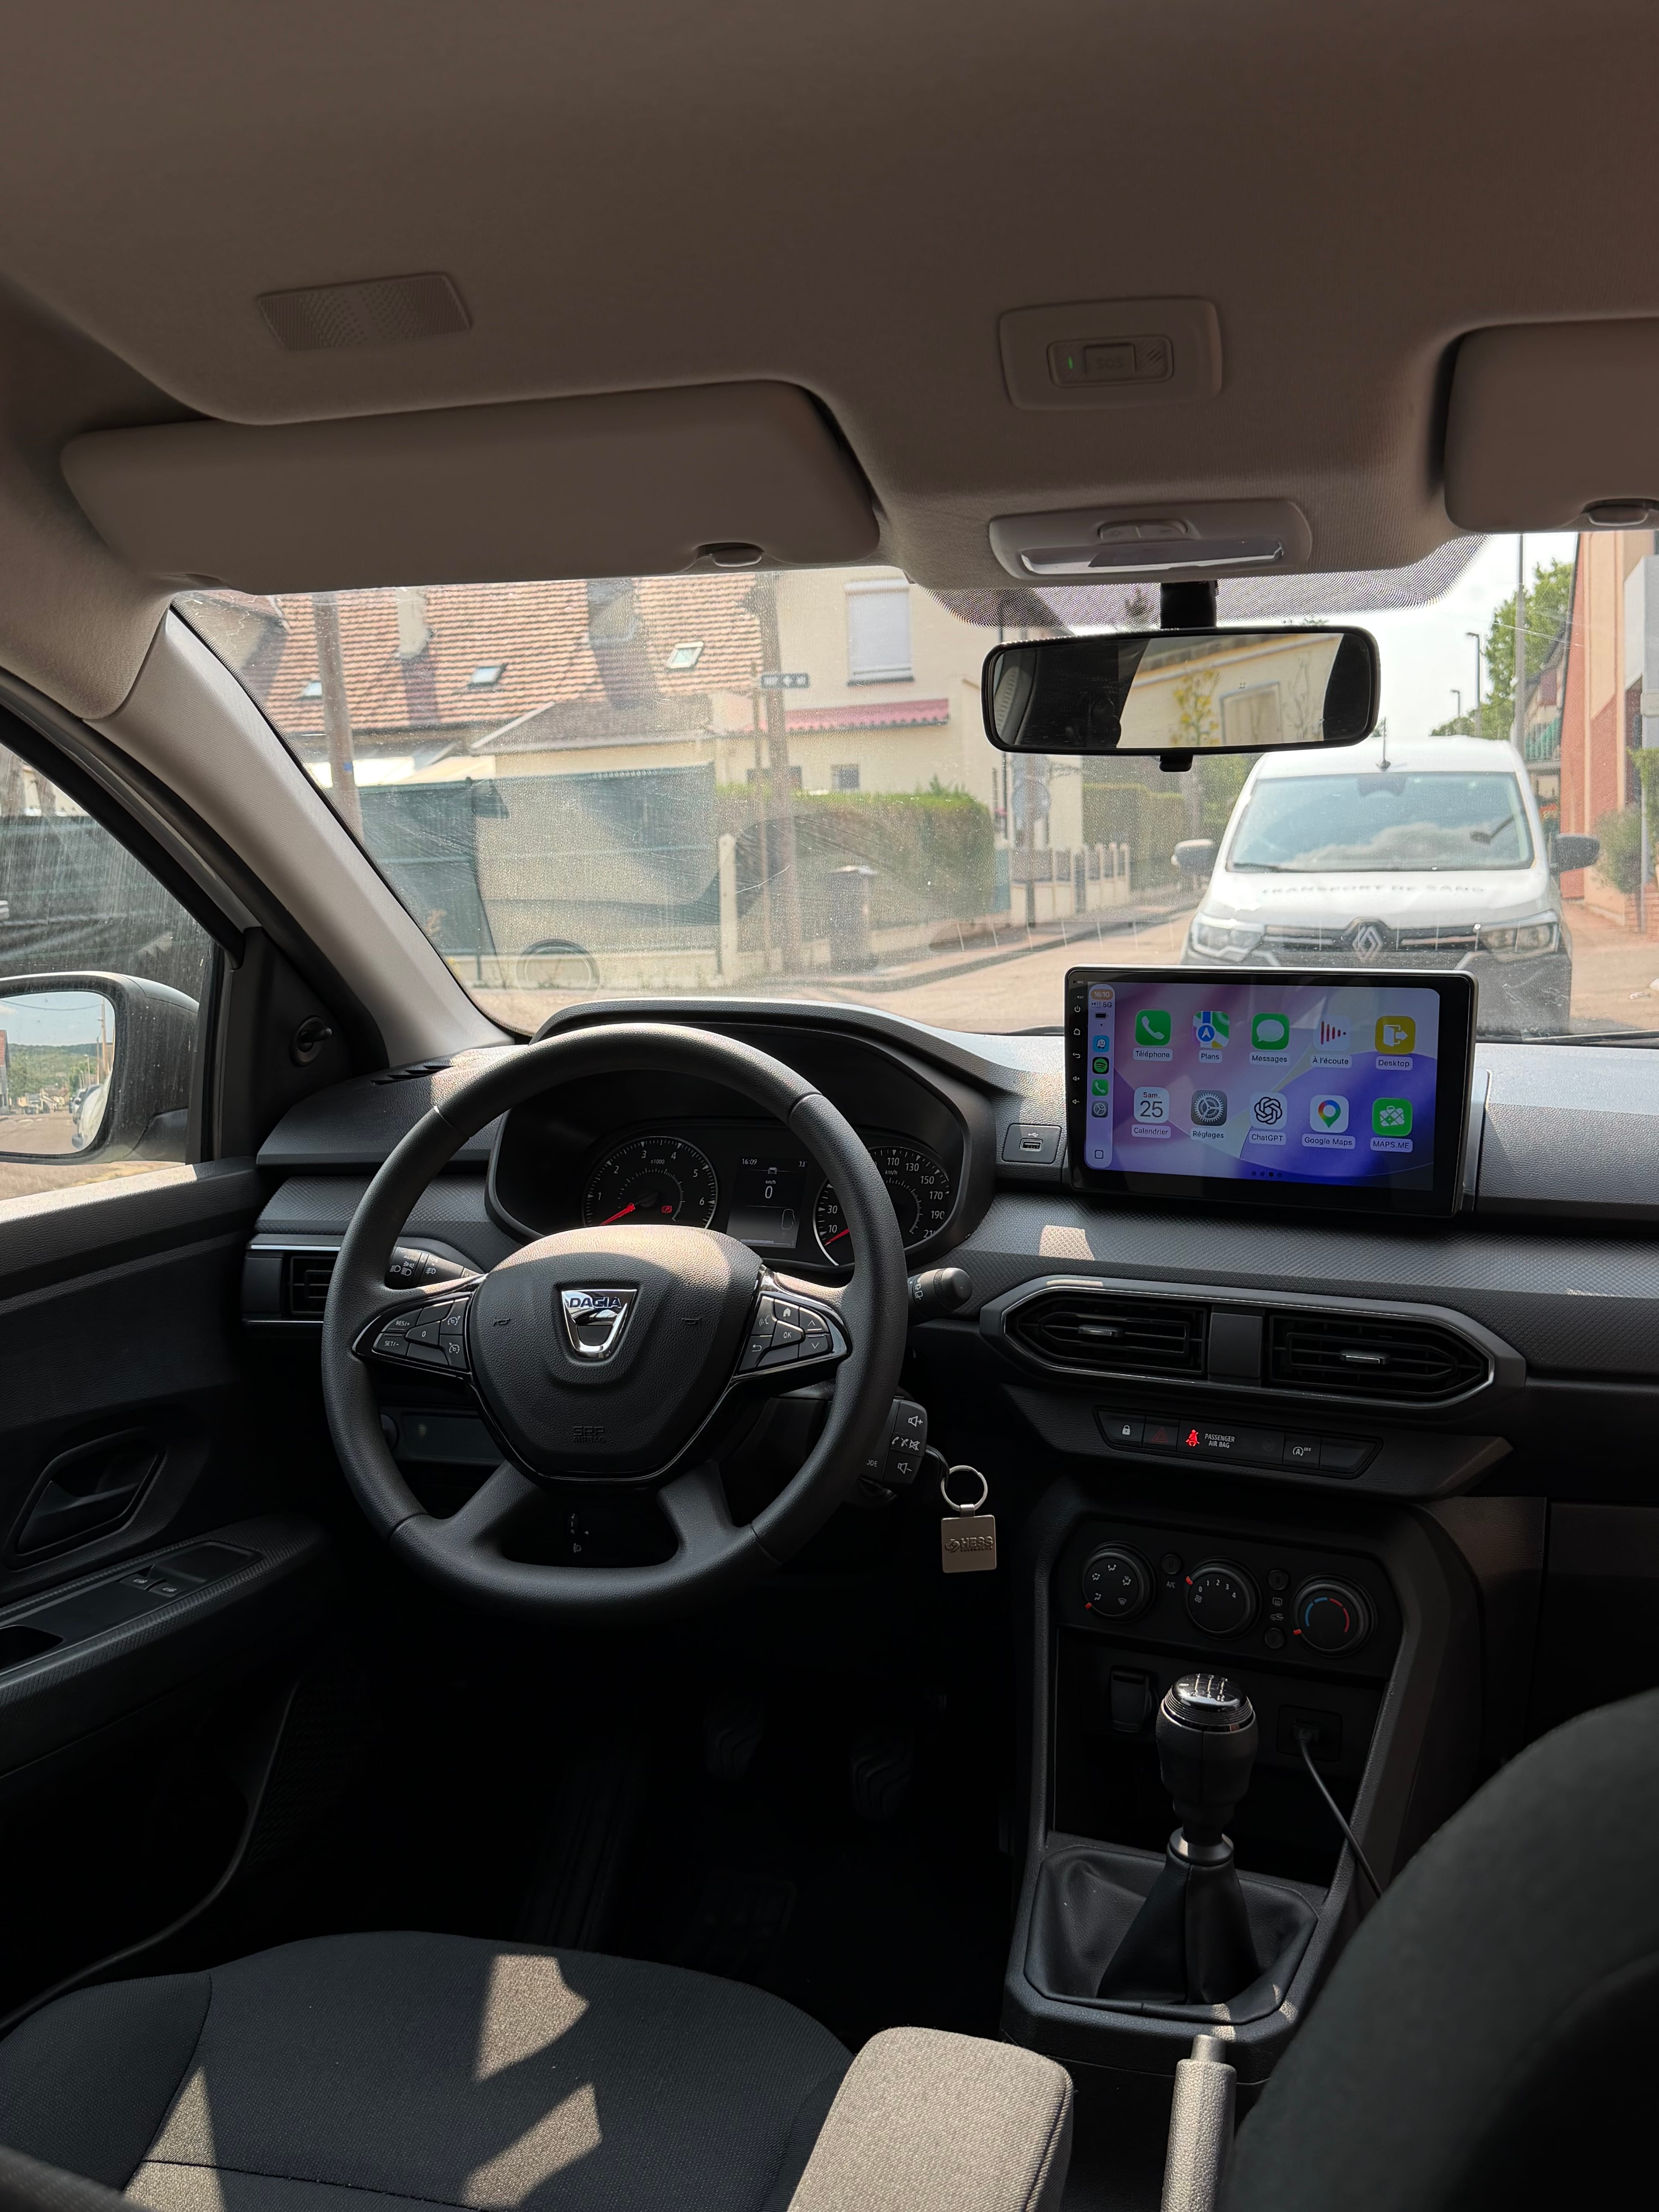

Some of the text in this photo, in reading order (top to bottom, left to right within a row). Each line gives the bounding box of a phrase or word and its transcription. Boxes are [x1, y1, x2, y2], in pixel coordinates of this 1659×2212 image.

[1096, 356, 1123, 370] SOS
[1135, 1050, 1170, 1059] Téléphone
[1319, 1057, 1349, 1065] l'écoute
[1378, 1060, 1410, 1068] Desktop
[1140, 1101, 1163, 1118] 25
[1134, 1128, 1168, 1136] Calendrier
[1193, 1130, 1224, 1140] Réglages
[1252, 1133, 1283, 1142] ChatGPT
[1304, 1137, 1352, 1147] Google Maps
[1373, 1140, 1410, 1149] MAPS.ME
[641, 1150, 647, 1158] 3
[671, 1151, 677, 1160] 4
[887, 1157, 900, 1166] 110
[614, 1165, 619, 1174] 2
[905, 1163, 919, 1171] 130
[693, 1170, 698, 1178] 5
[920, 1175, 934, 1184] 150
[765, 1186, 773, 1199] 0
[929, 1191, 943, 1200] 170
[827, 1206, 838, 1214] 30
[931, 1211, 945, 1219] 190
[828, 1224, 837, 1233] 10
[924, 1230, 936, 1238] 21
[570, 1297, 622, 1308] DACIA
[1205, 1433, 1235, 1443] PASSENGER
[866, 1459, 878, 1467] ODE
[961, 1536, 993, 1547] HESS
